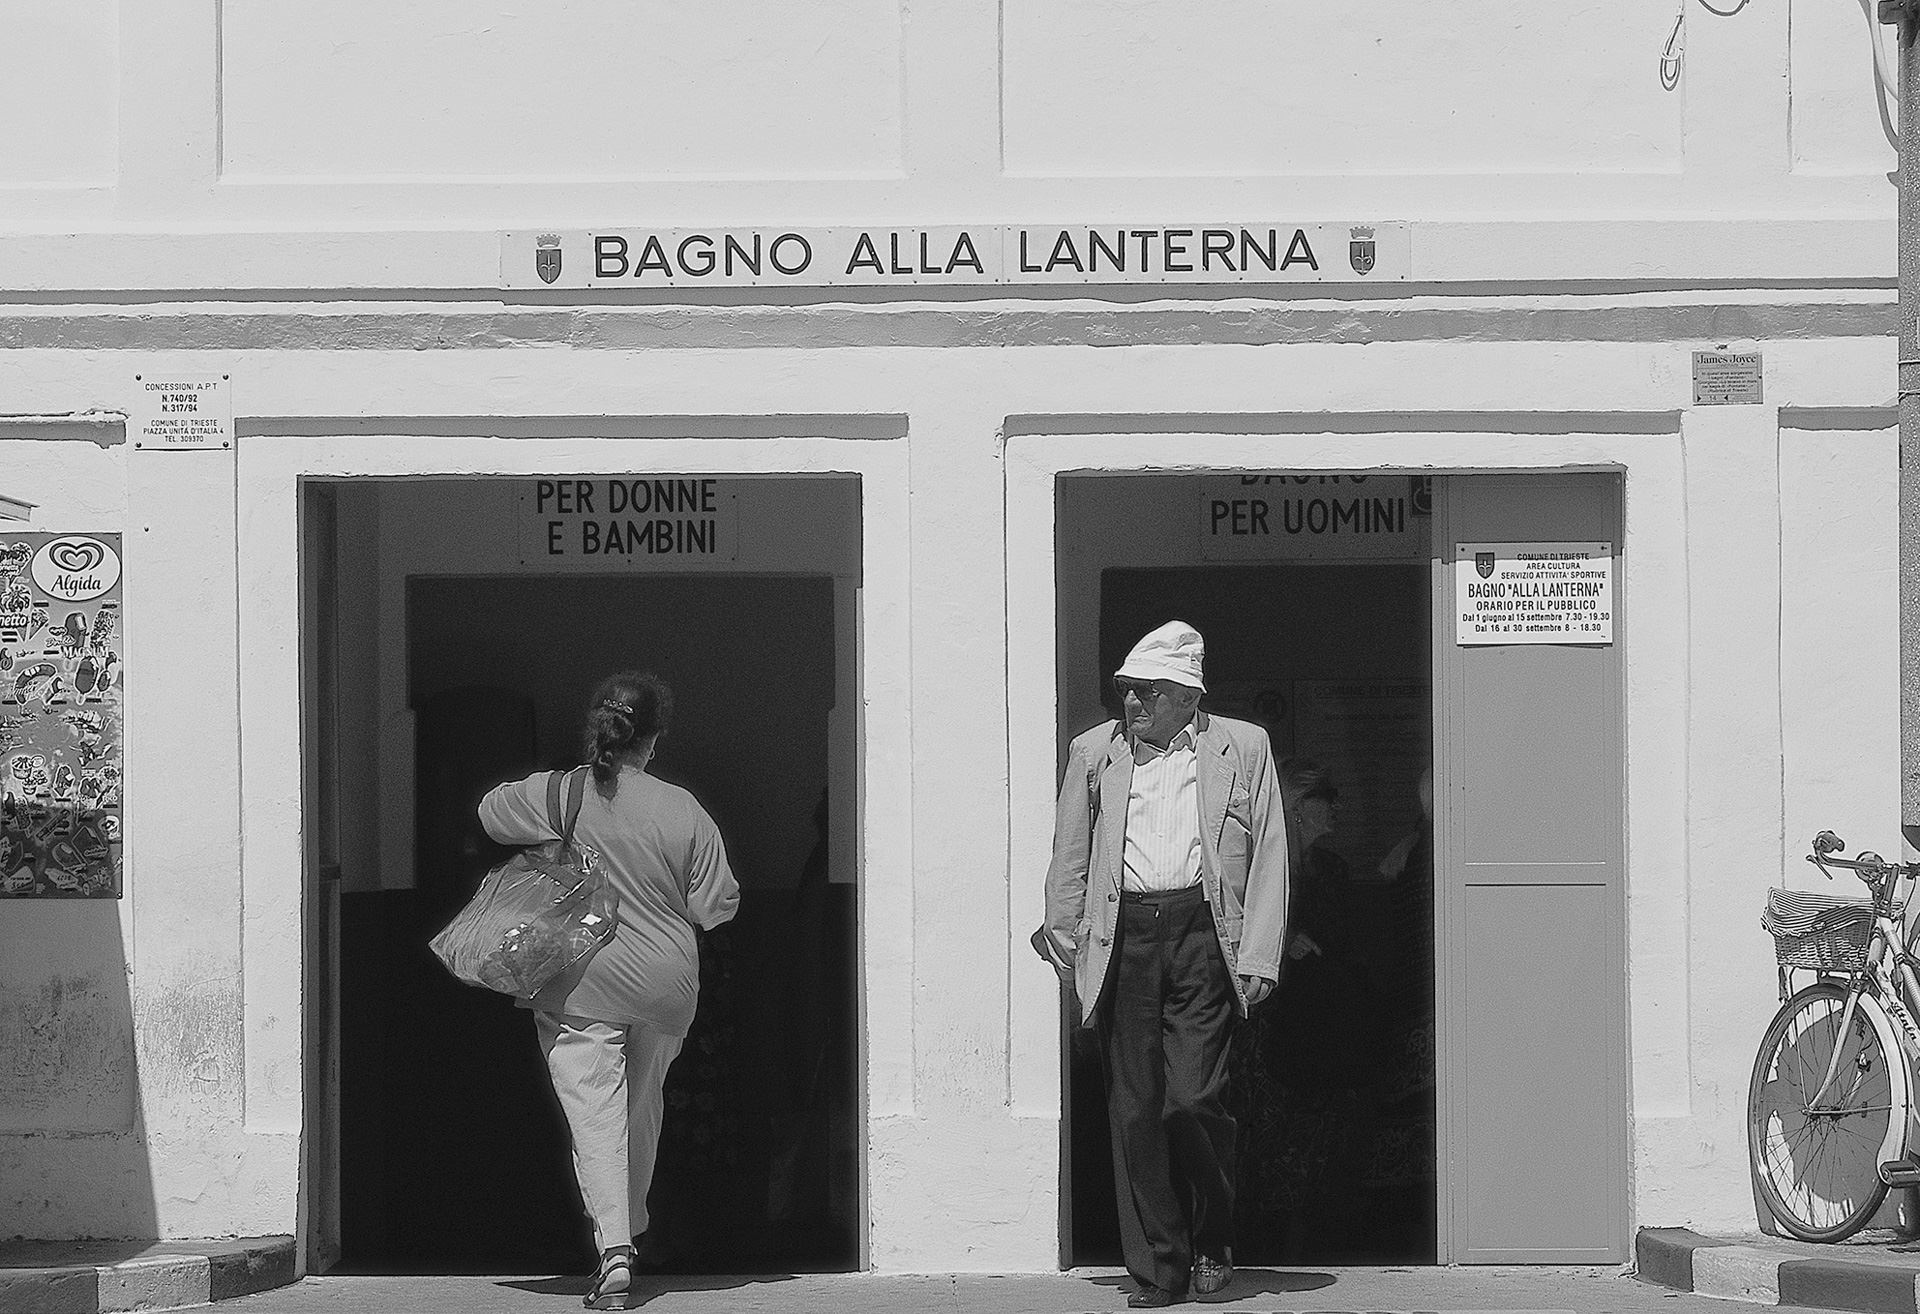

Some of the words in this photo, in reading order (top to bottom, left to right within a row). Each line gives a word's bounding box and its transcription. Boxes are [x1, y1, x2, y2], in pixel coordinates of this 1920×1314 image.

[594, 233, 812, 279] BAGNO
[845, 232, 984, 275] ALLA
[1019, 229, 1319, 273] LANTERNA
[1697, 354, 1728, 364] James
[1729, 354, 1757, 366] Joyce
[145, 383, 194, 391] CONCESSIONI
[161, 394, 198, 403] N.740/92
[161, 404, 198, 412] N.317/94
[151, 419, 178, 427] COMUNE
[143, 427, 167, 435] PIAZZA
[536, 480, 595, 514] PER
[609, 479, 717, 514] DONNE
[1211, 500, 1270, 535] PER
[1284, 498, 1404, 534] UOMINI
[548, 521, 563, 555] E
[583, 519, 715, 554] BAMBINI
[1560, 552, 1589, 560] TRIESTE
[1547, 562, 1581, 570] CULTURA
[1535, 571, 1569, 579] ATTIVITA'
[1570, 571, 1606, 579] SPORTIVE
[51, 574, 102, 598] Algida
[1468, 583, 1506, 598] BAGNO
[1476, 601, 1514, 611] ORARIO
[1515, 601, 1534, 611] PER
[1536, 601, 1545, 611] IL
[1547, 600, 1596, 610] PUBBLICO
[1462, 613, 1475, 621] Dal
[1476, 613, 1480, 621] 1
[1482, 614, 1507, 623] giugno
[1508, 613, 1515, 621] al
[1516, 613, 1525, 621] 15
[1526, 613, 1562, 621] settembre
[1565, 612, 1582, 621] 7.30
[1588, 612, 1610, 621] 19.30
[1475, 624, 1488, 632] Dal
[1490, 624, 1500, 632] 16
[1503, 624, 1510, 632] al
[1513, 624, 1523, 632] 30
[1525, 624, 1562, 632] settembre
[1564, 623, 1570, 631] 8
[1580, 623, 1602, 631] 18.30
[61, 644, 109, 658] MAGNUM
